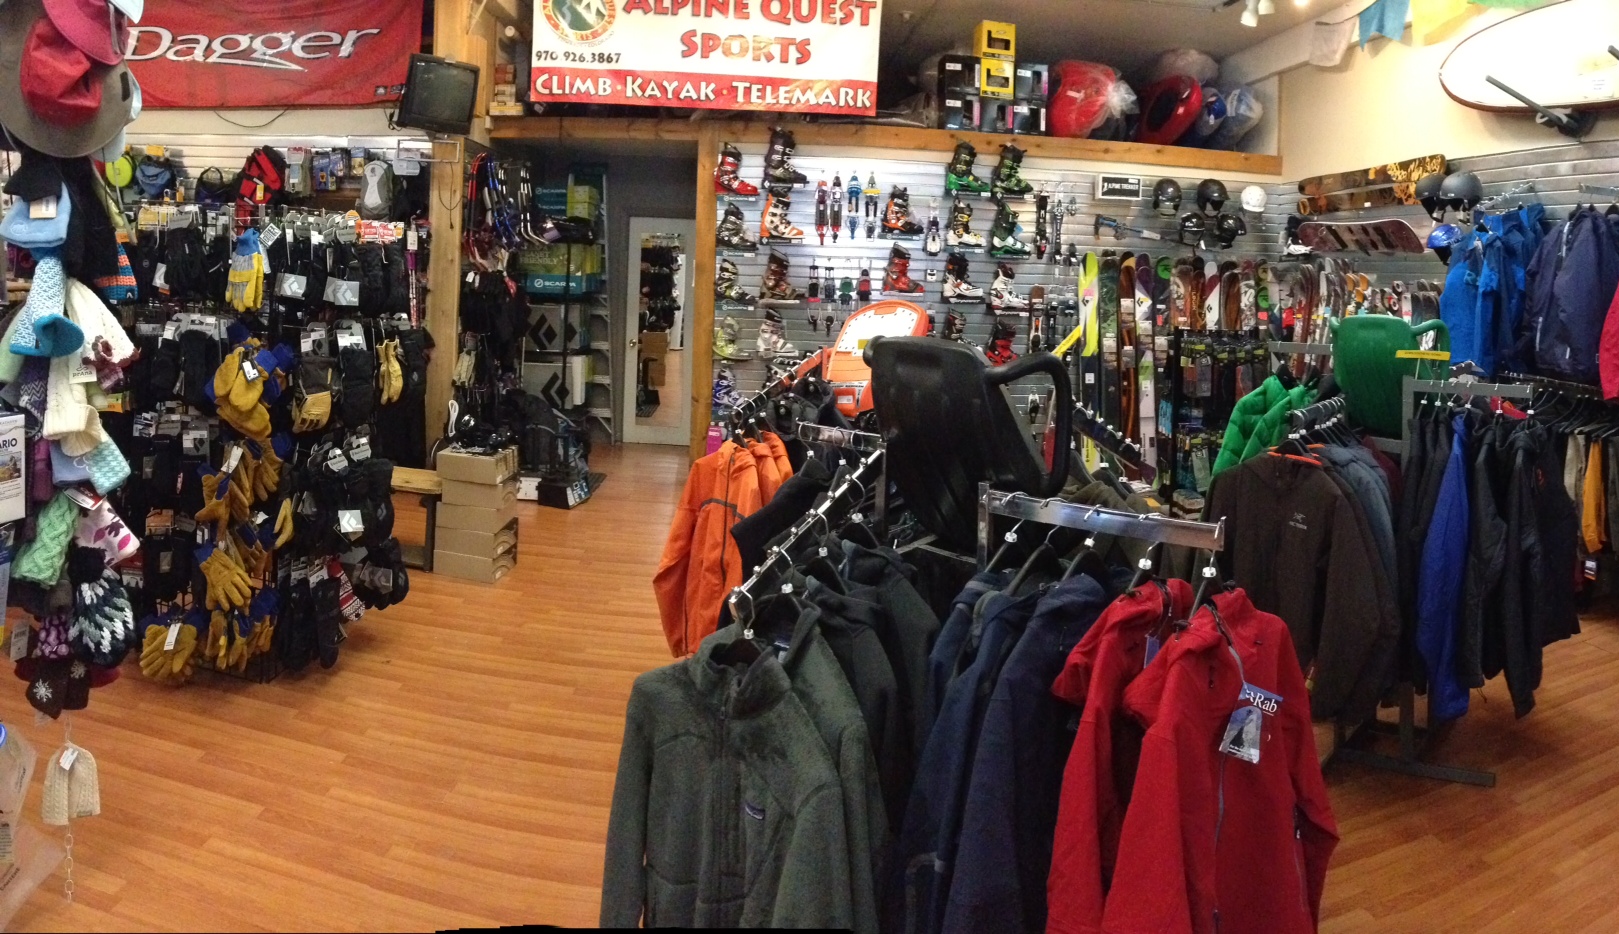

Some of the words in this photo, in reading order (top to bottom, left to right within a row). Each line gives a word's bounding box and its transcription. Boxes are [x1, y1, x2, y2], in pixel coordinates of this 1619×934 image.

[760, 0, 877, 26] QUEST
[123, 26, 381, 72] Dagger
[680, 29, 812, 65] SPORTS
[535, 73, 613, 96] CLIMB
[625, 75, 716, 101] KAYAK
[731, 81, 872, 109] TELEMARK
[72, 370, 93, 378] prAna
[1254, 692, 1278, 713] Rab
